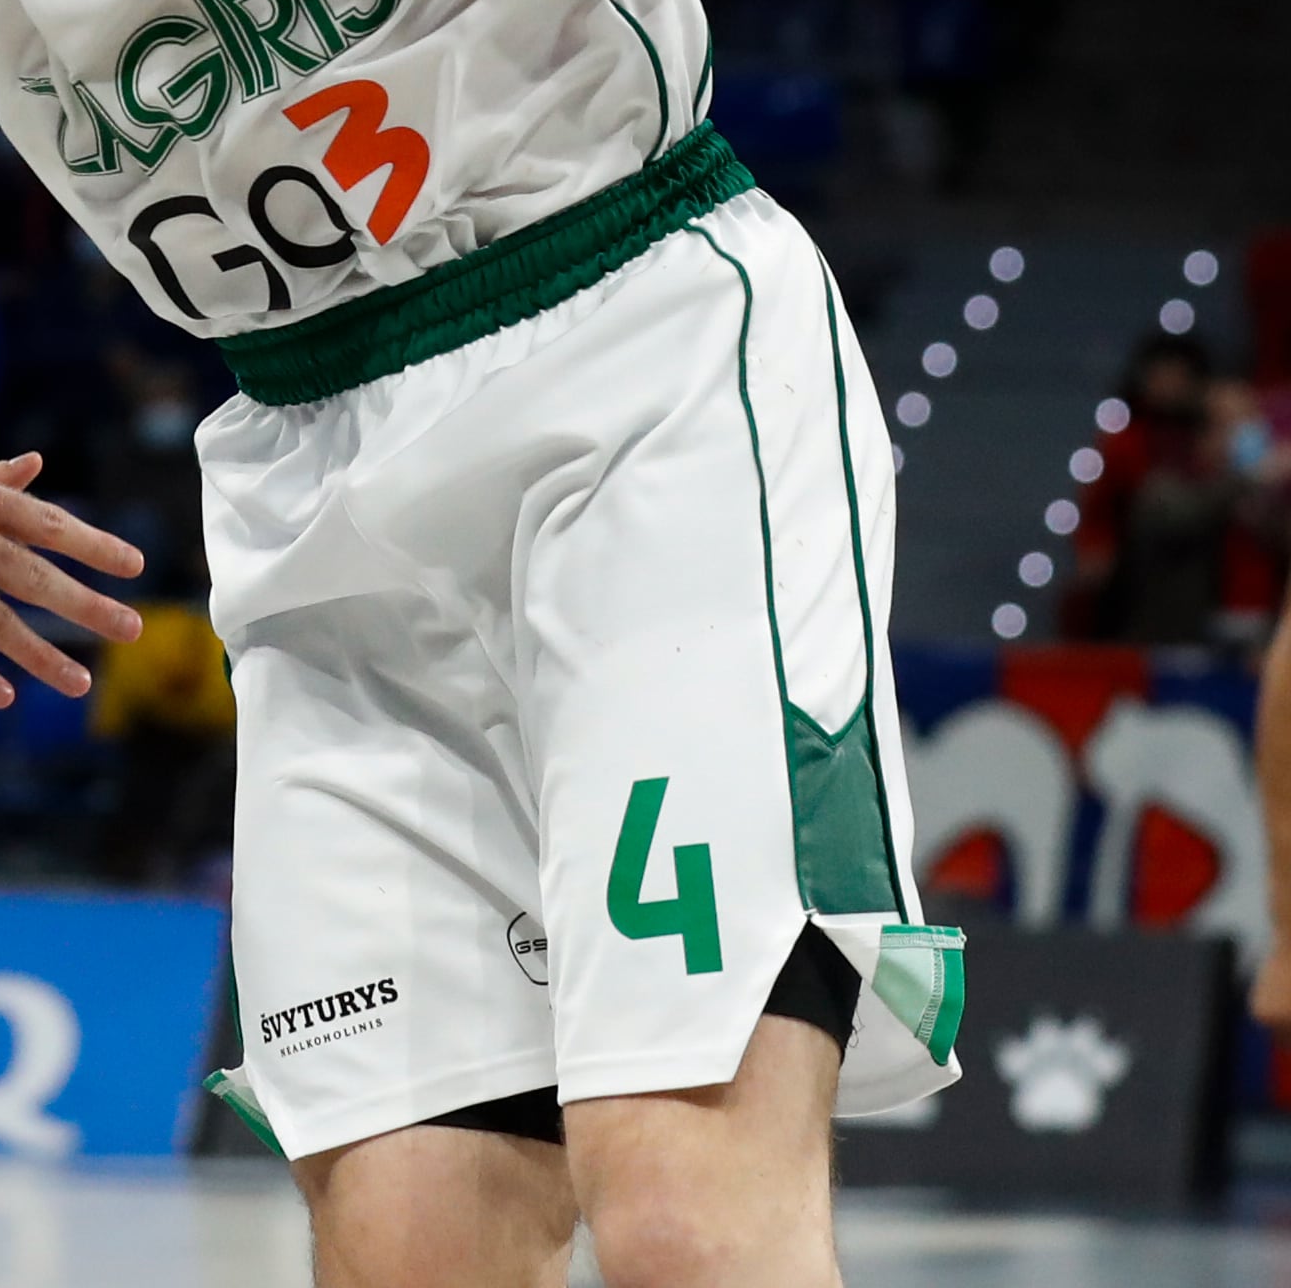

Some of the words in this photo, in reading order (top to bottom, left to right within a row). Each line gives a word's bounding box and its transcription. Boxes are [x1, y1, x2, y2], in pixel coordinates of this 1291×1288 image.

[606, 776, 723, 975] 4
[260, 977, 399, 1044] ŠVYTURYS
[280, 1017, 384, 1058] NEALKOHOLINIS
